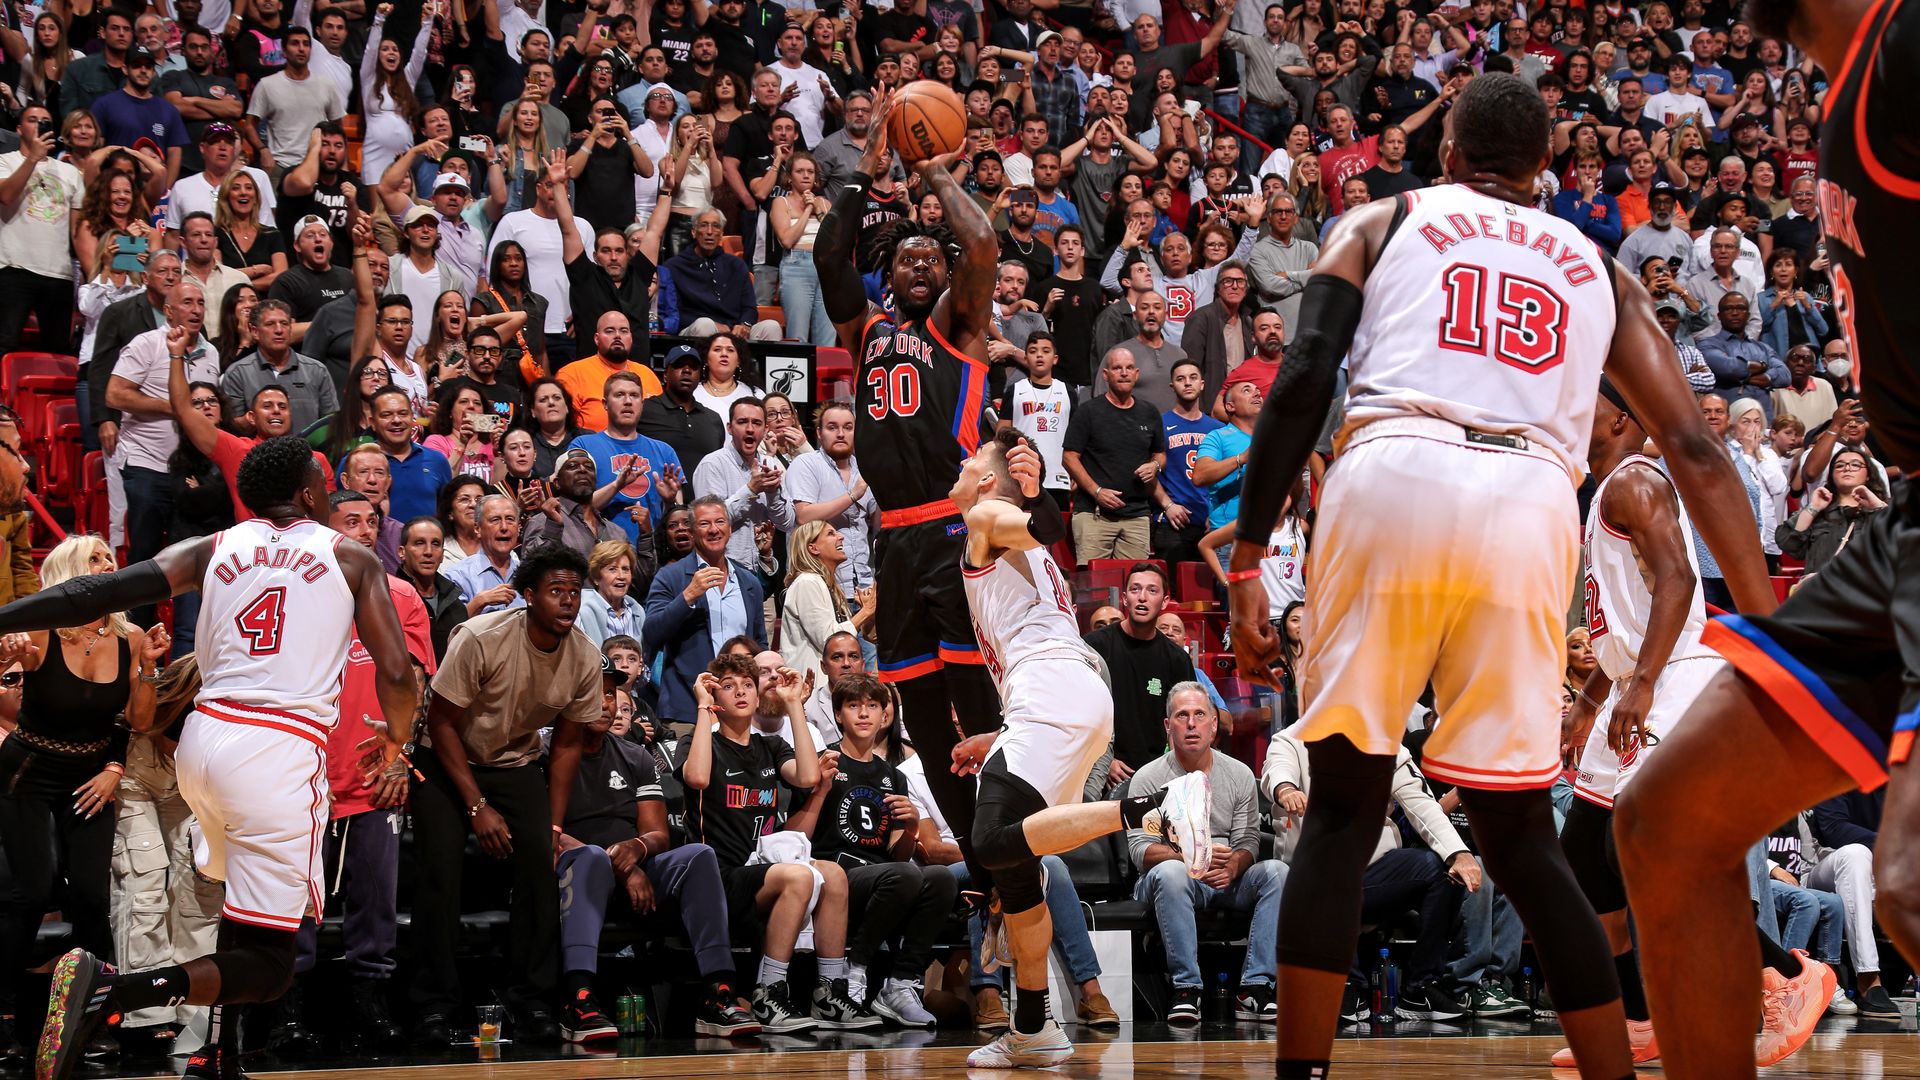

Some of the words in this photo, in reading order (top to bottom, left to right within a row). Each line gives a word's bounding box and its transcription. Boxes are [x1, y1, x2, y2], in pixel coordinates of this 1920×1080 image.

[661, 39, 691, 51] MIAMI
[673, 50, 688, 62] 22
[1788, 160, 1816, 170] MIAMI
[328, 209, 348, 227] 13
[863, 211, 883, 229] NEW
[1418, 212, 1598, 287] ADEBAYO
[1166, 285, 1195, 322] 3
[1438, 261, 1570, 375] 13
[865, 336, 892, 365] EW
[895, 333, 934, 369] ORK
[867, 362, 920, 421] 30
[1022, 401, 1062, 416] MIAMI
[1037, 416, 1059, 432] 22
[1168, 432, 1191, 449] NEW
[214, 546, 330, 586] OLADIPO
[1279, 561, 1295, 580] 13
[234, 586, 288, 657] 4
[726, 783, 777, 810] MIAMI
[849, 787, 874, 800] SLEEPS
[839, 797, 852, 826] NEVER
[860, 805, 873, 831] 5
[752, 815, 776, 841] 14
[841, 827, 859, 843] CITY
